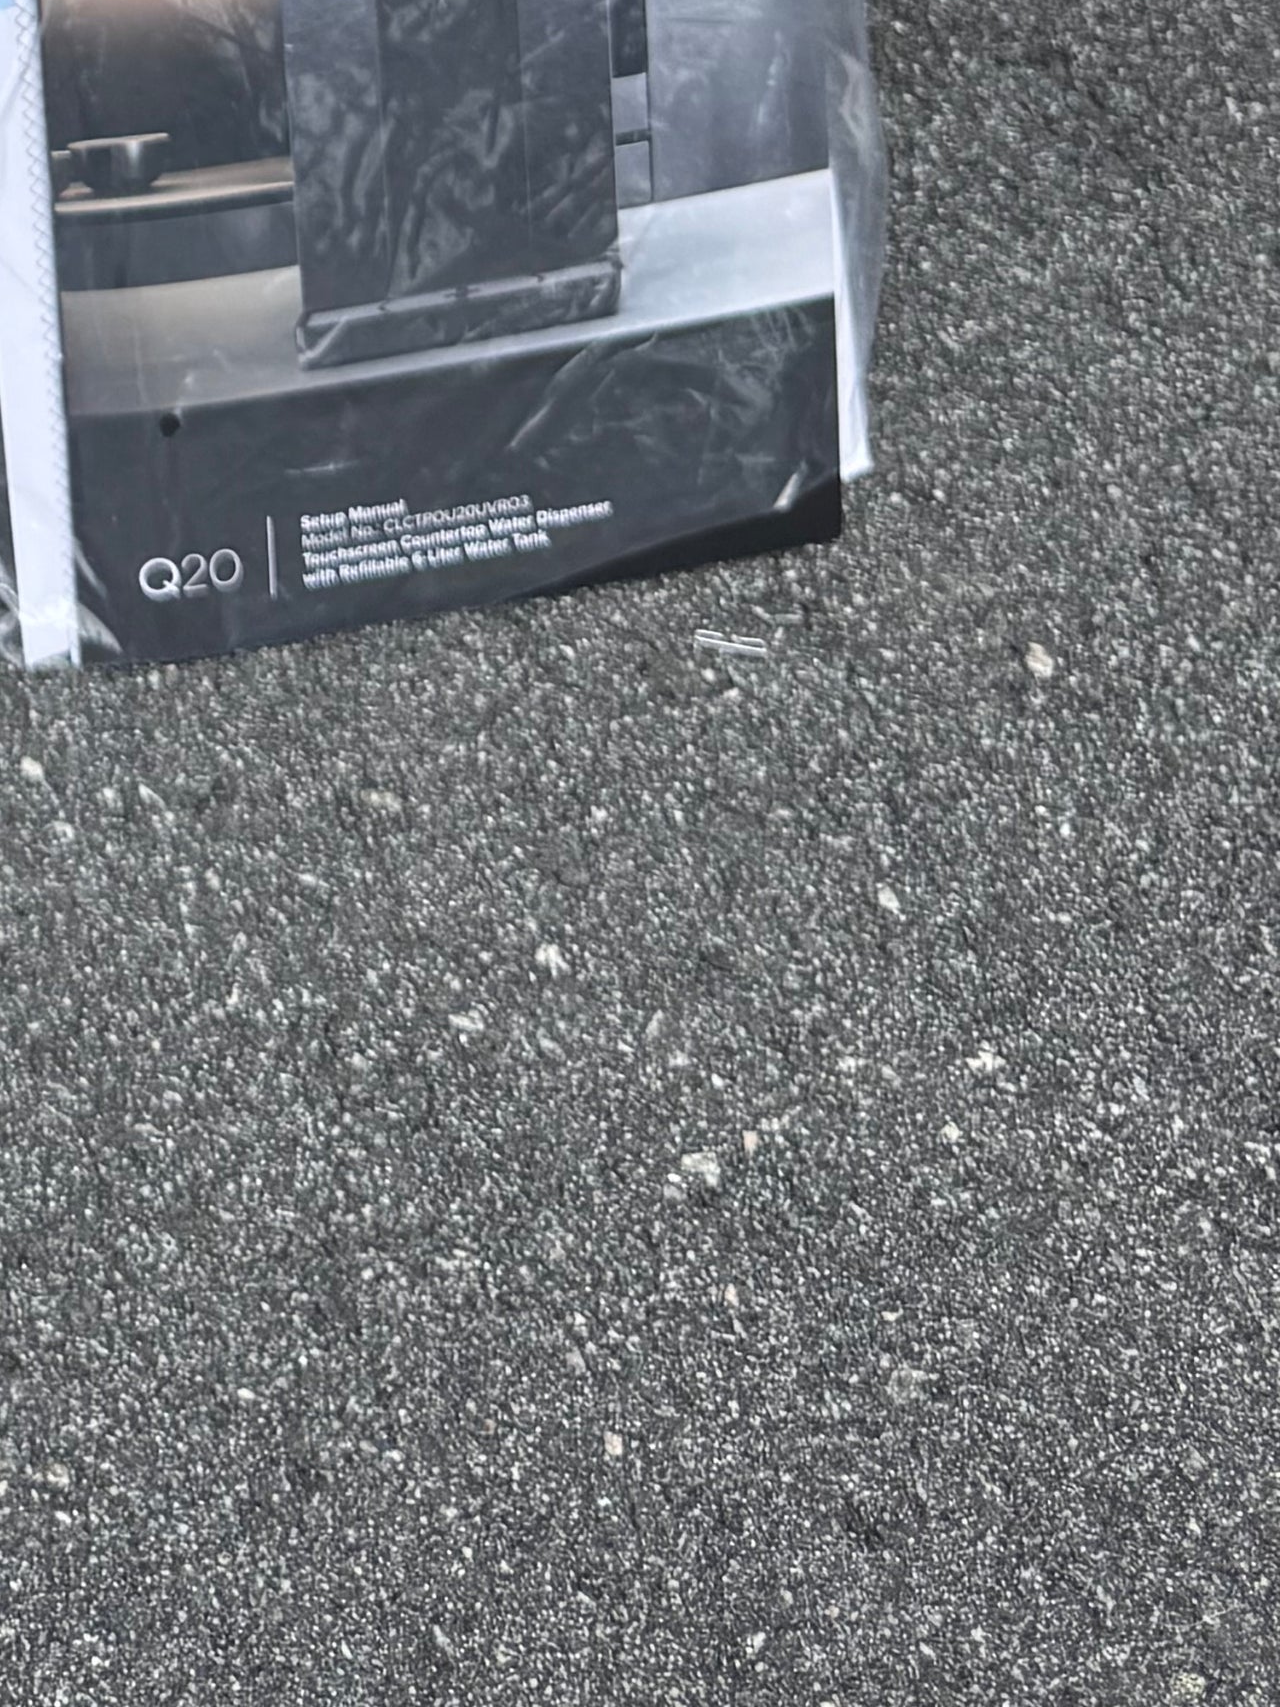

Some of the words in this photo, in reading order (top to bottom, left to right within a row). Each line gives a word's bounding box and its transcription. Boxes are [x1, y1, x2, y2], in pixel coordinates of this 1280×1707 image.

[300, 511, 348, 533] Setup
[347, 498, 408, 525] Manual
[301, 529, 348, 552] Model
[302, 539, 402, 571] Touchscreen
[399, 522, 490, 553] Countertop
[488, 514, 536, 537] Water
[535, 499, 614, 530] Dispenser
[138, 547, 244, 601] Q20
[302, 567, 340, 589] with
[338, 556, 413, 584] Refillable
[411, 546, 466, 573] 6-Liter
[463, 537, 513, 562] Water
[511, 528, 553, 552] Tank
